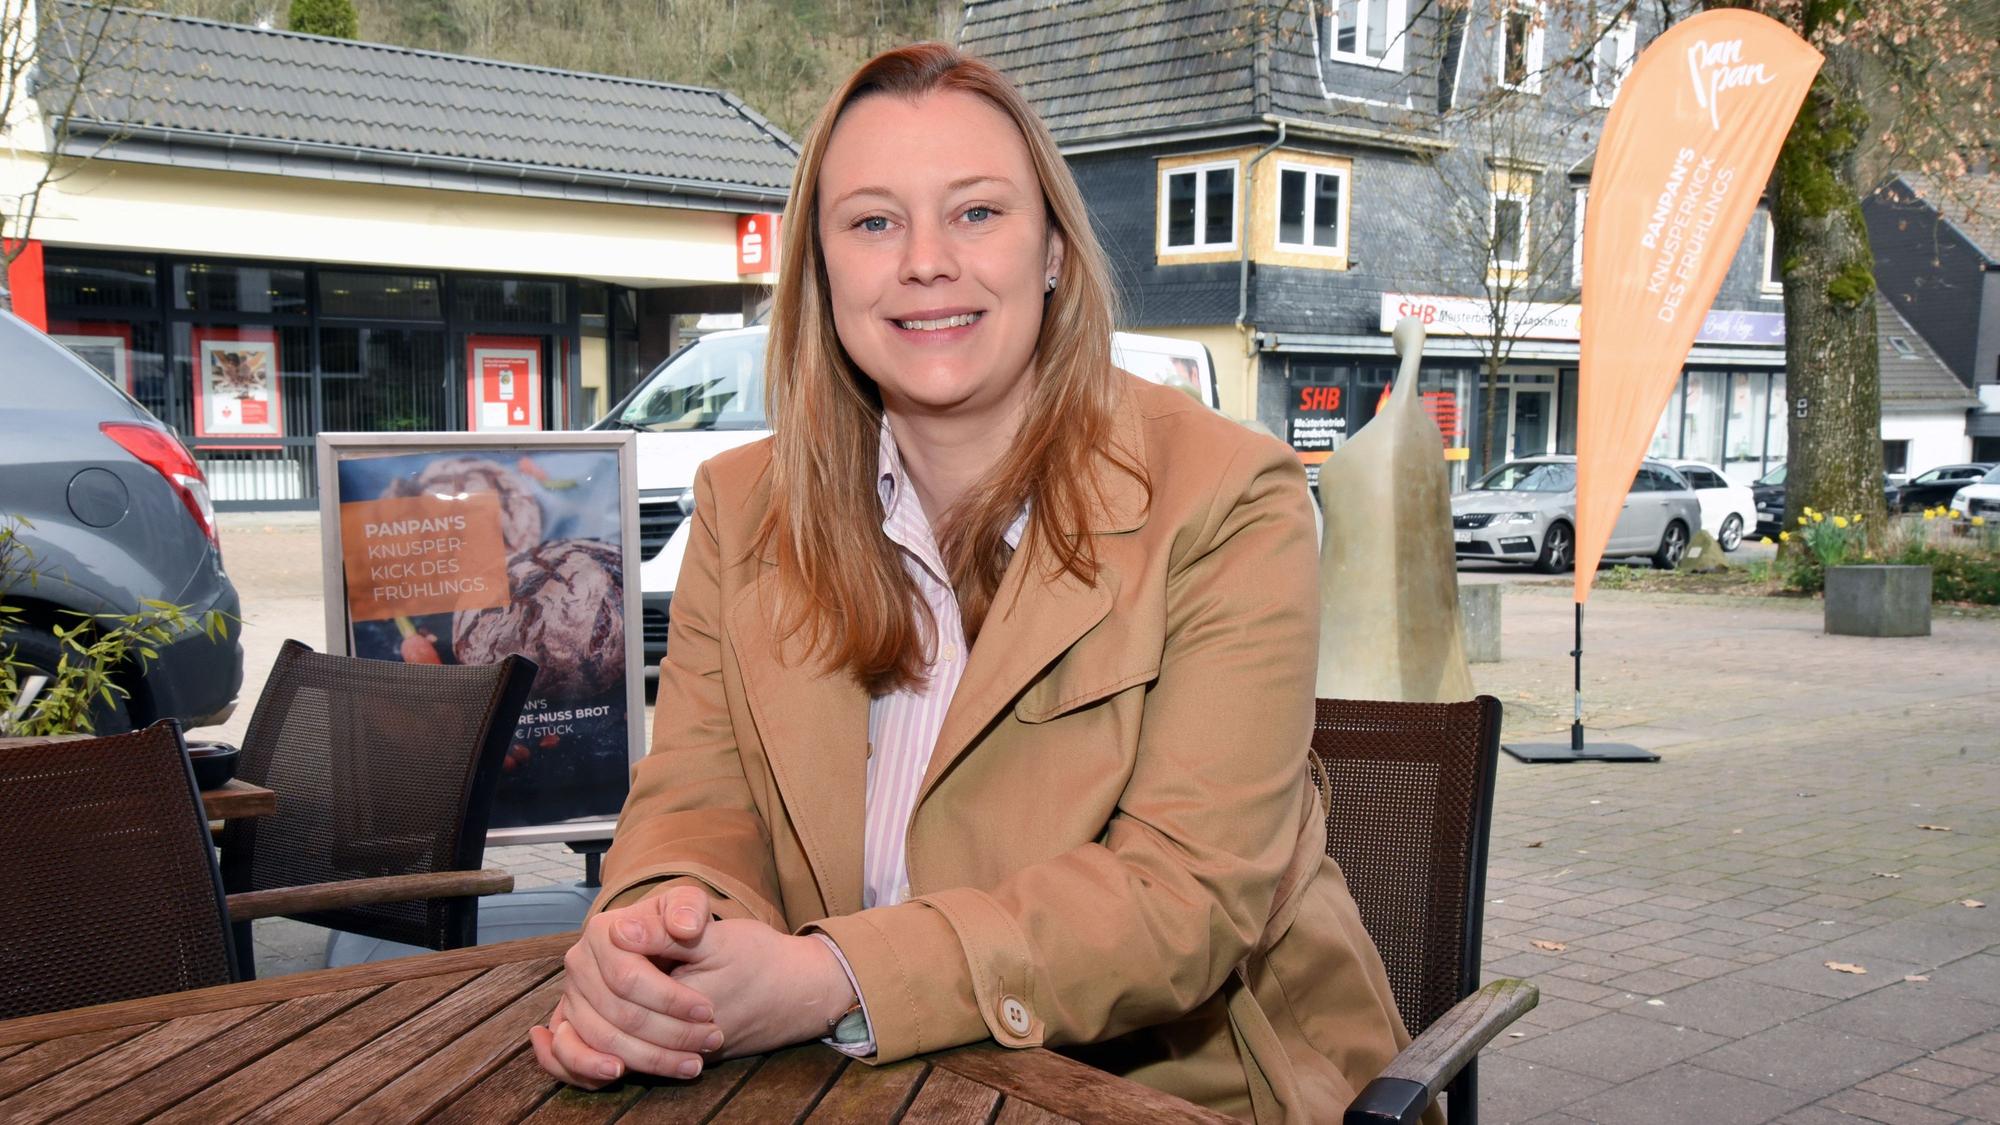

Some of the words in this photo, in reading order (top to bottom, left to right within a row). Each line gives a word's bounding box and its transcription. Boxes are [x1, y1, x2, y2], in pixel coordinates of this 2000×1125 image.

[1641, 147, 1695, 249] PANPAN'S
[1647, 155, 1716, 294] KNUSPERKICK
[1658, 281, 1686, 323] DES
[1300, 386, 1341, 411] SHB
[364, 515, 467, 538] PANPAN'S
[368, 537, 468, 560] KNUSPER-
[371, 562, 417, 581] KICK
[421, 558, 460, 576] DES
[373, 577, 489, 601] FRÜHLINGS.
[575, 705, 610, 719] BROT
[534, 723, 574, 737] STÜCK
